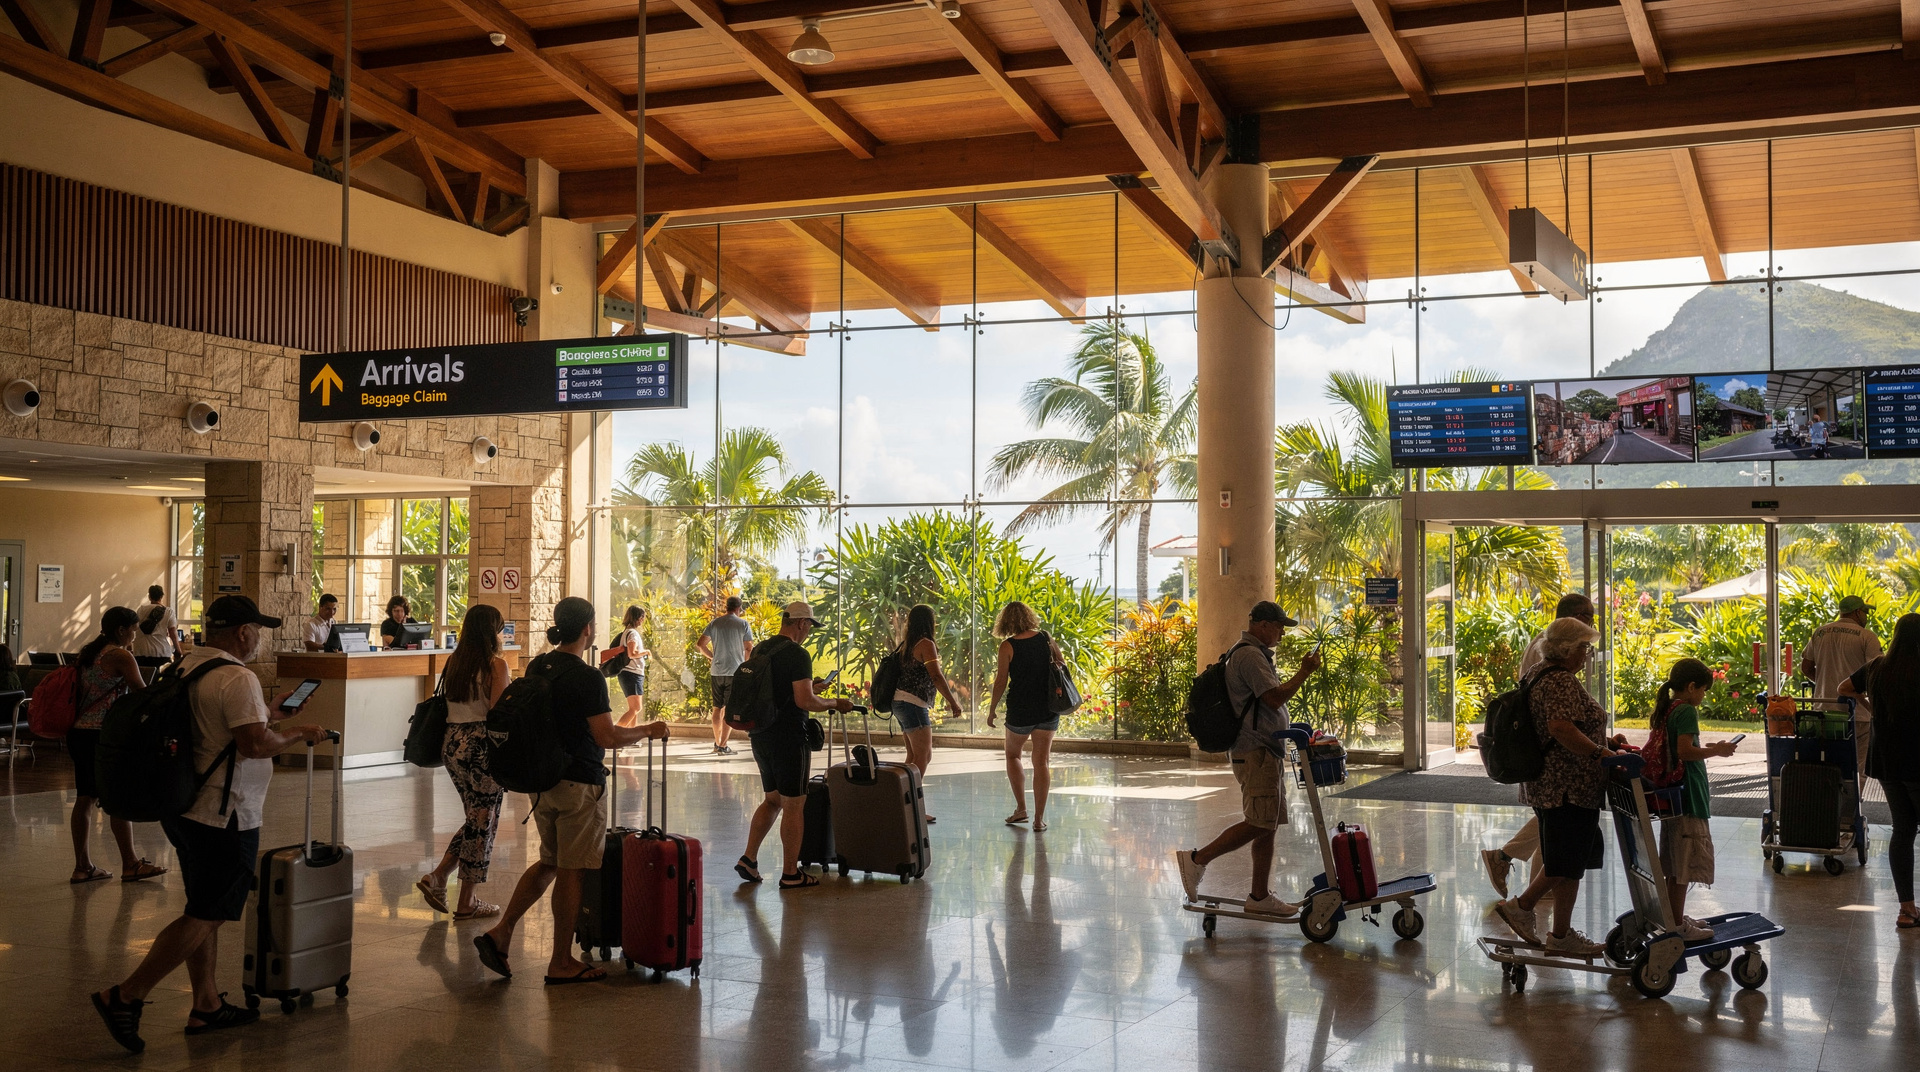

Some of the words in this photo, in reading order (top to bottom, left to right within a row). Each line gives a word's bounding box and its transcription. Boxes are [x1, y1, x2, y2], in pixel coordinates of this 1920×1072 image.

[360, 354, 465, 387] Arrivals
[361, 393, 410, 408] Baggage
[413, 389, 447, 403] Claim
